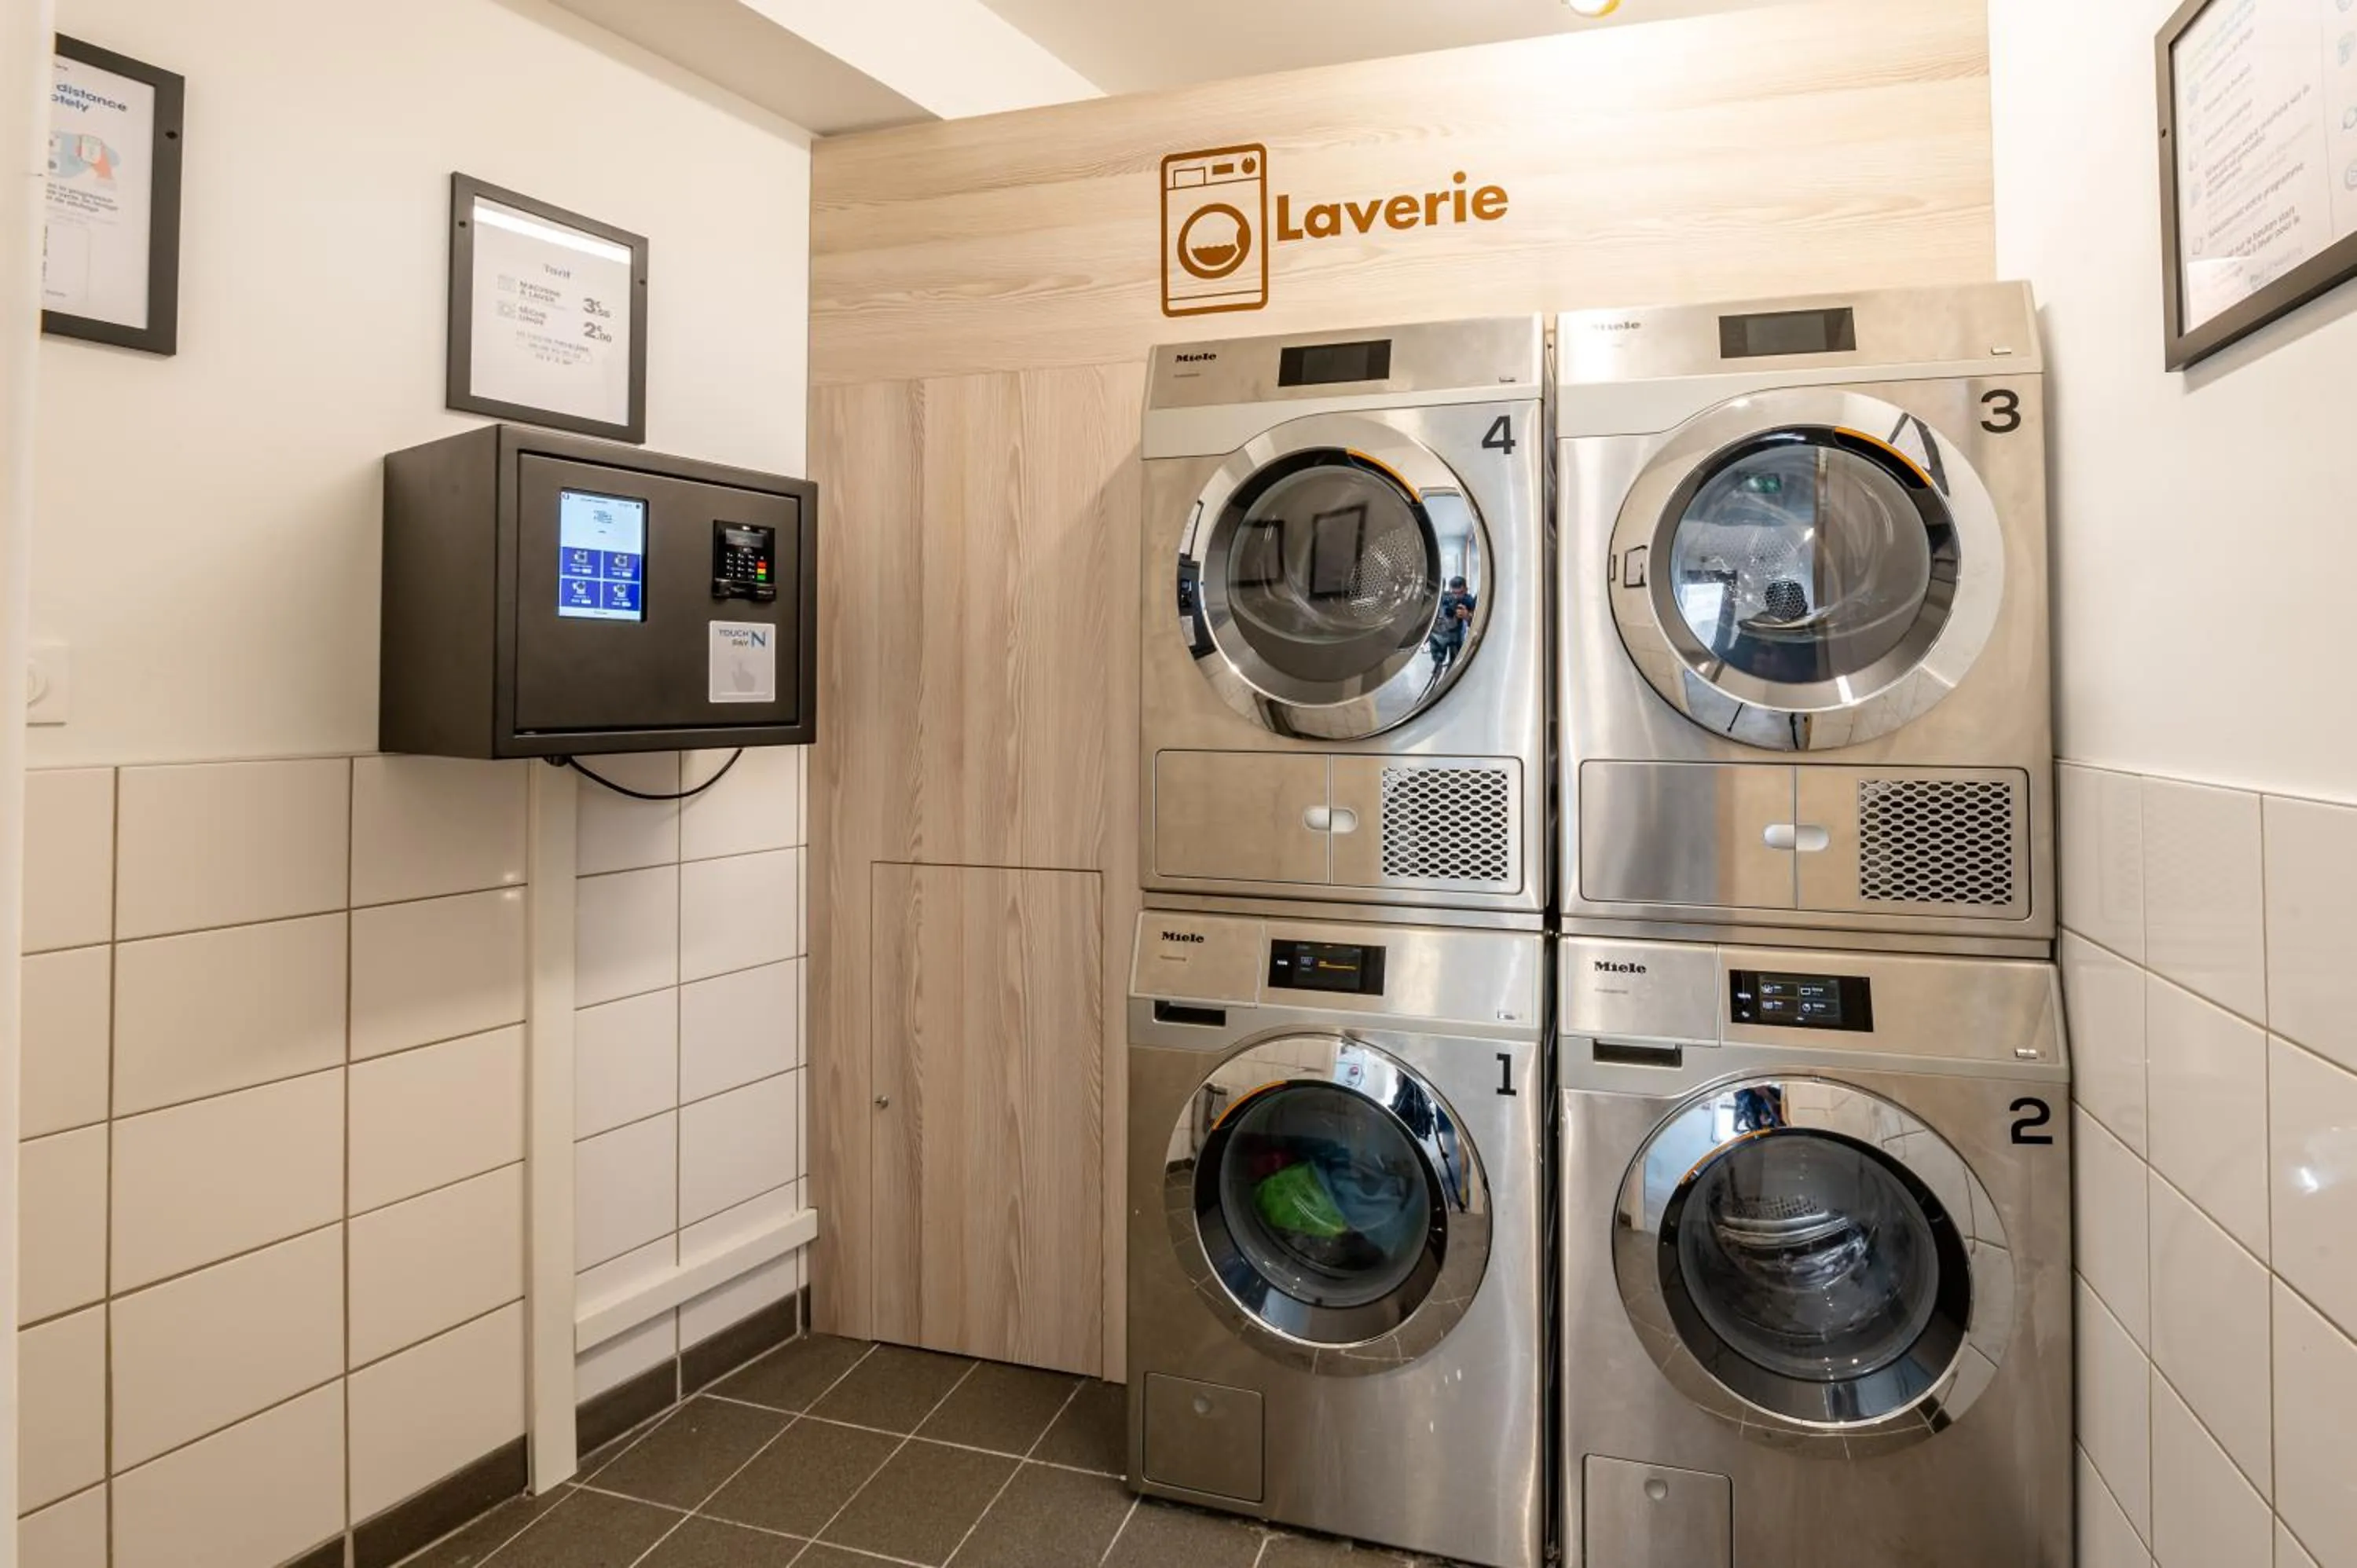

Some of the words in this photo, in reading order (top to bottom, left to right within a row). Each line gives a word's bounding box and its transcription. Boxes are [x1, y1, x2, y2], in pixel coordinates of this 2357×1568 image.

[56, 84, 127, 112] distance
[1277, 171, 1508, 241] Laverie
[1175, 353, 1217, 362] Miele
[1980, 389, 2022, 434] 3
[1481, 414, 1516, 455] 4
[1161, 931, 1204, 943] Miele
[1594, 961, 1647, 973] Miele
[1495, 1053, 1517, 1097] 1
[2009, 1097, 2054, 1145] 2
